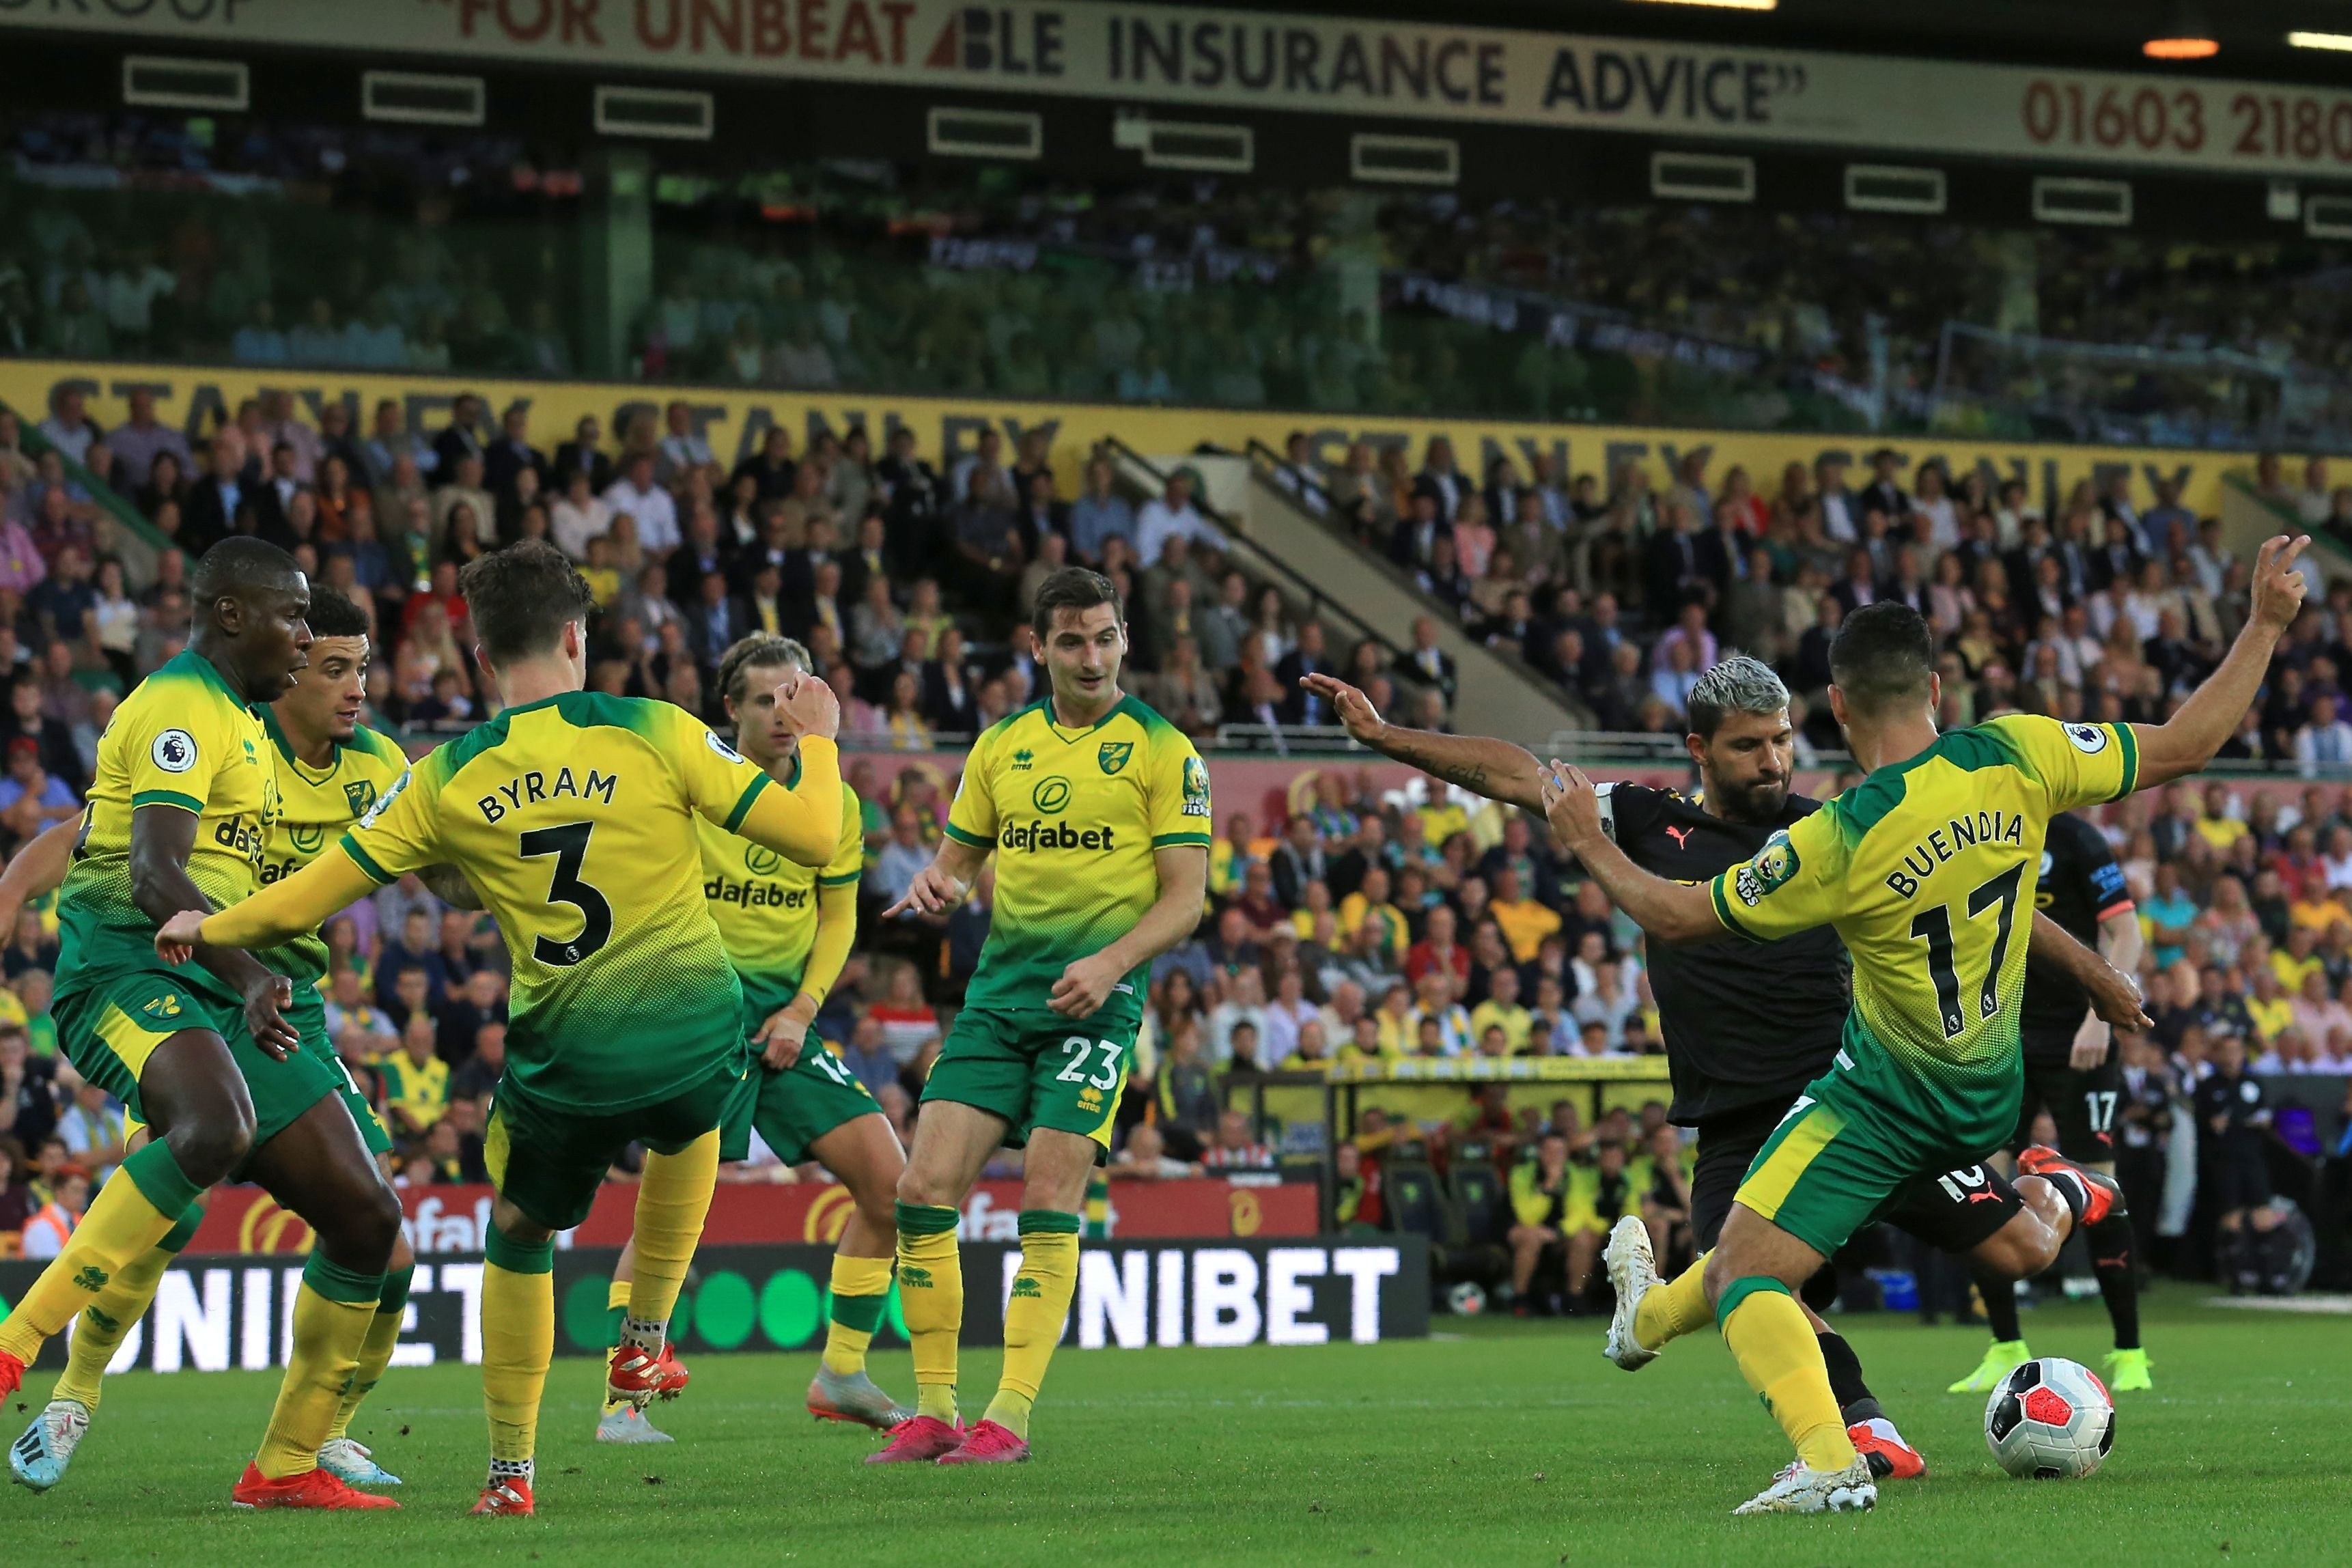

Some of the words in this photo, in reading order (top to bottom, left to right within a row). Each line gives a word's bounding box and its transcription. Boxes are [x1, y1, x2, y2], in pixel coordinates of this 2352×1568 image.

[1108, 16, 1506, 104] INSURANCE
[2022, 80, 2206, 152] 01603
[2232, 92, 2352, 162] 2180
[477, 766, 617, 824] BYRAM
[1002, 820, 1115, 854] dafabet
[1886, 810, 2024, 900] BUENDIA
[519, 821, 614, 968] 3
[703, 875, 808, 909] dafabet
[1909, 859, 2028, 1040] 17
[1056, 1035, 1123, 1091] 23
[2085, 1091, 2117, 1132] 17
